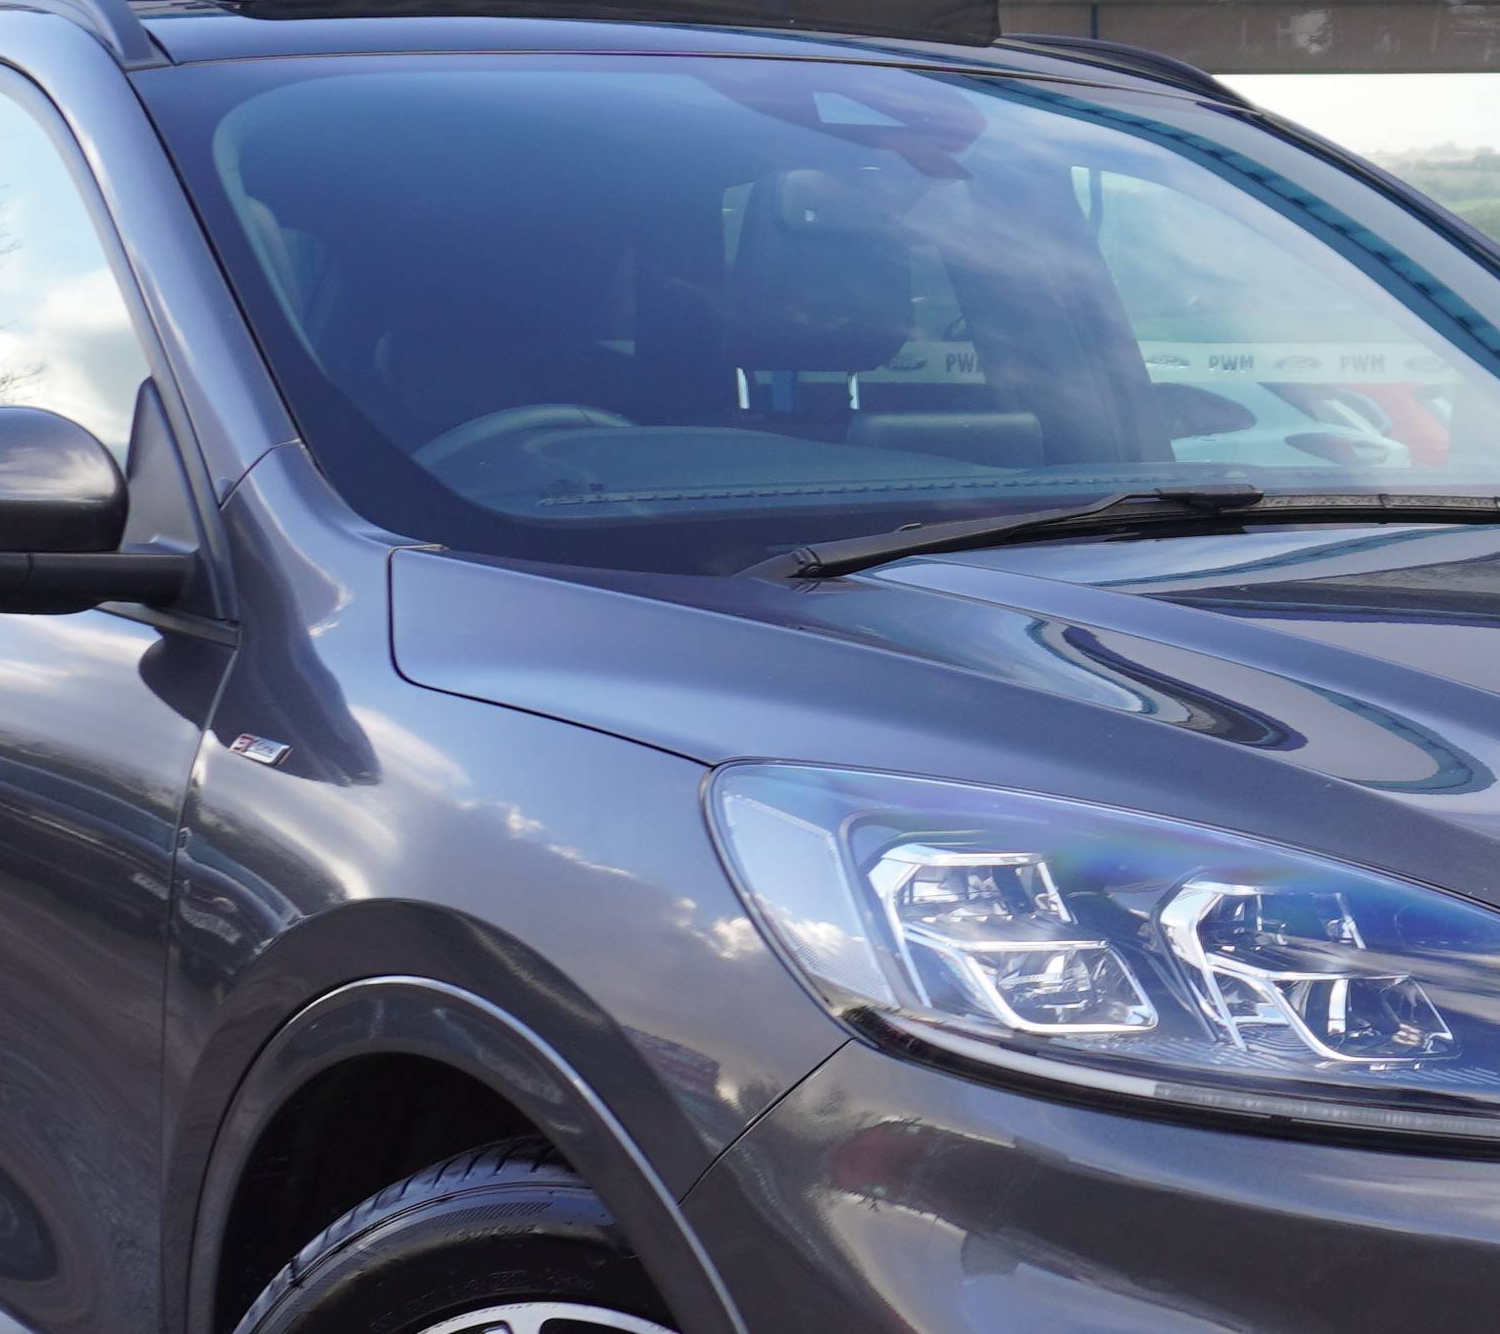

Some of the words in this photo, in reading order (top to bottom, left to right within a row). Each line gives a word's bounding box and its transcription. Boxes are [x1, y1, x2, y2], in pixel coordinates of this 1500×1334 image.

[945, 353, 976, 373] PW
[1209, 355, 1255, 373] PWM
[1340, 354, 1386, 374] PWM
